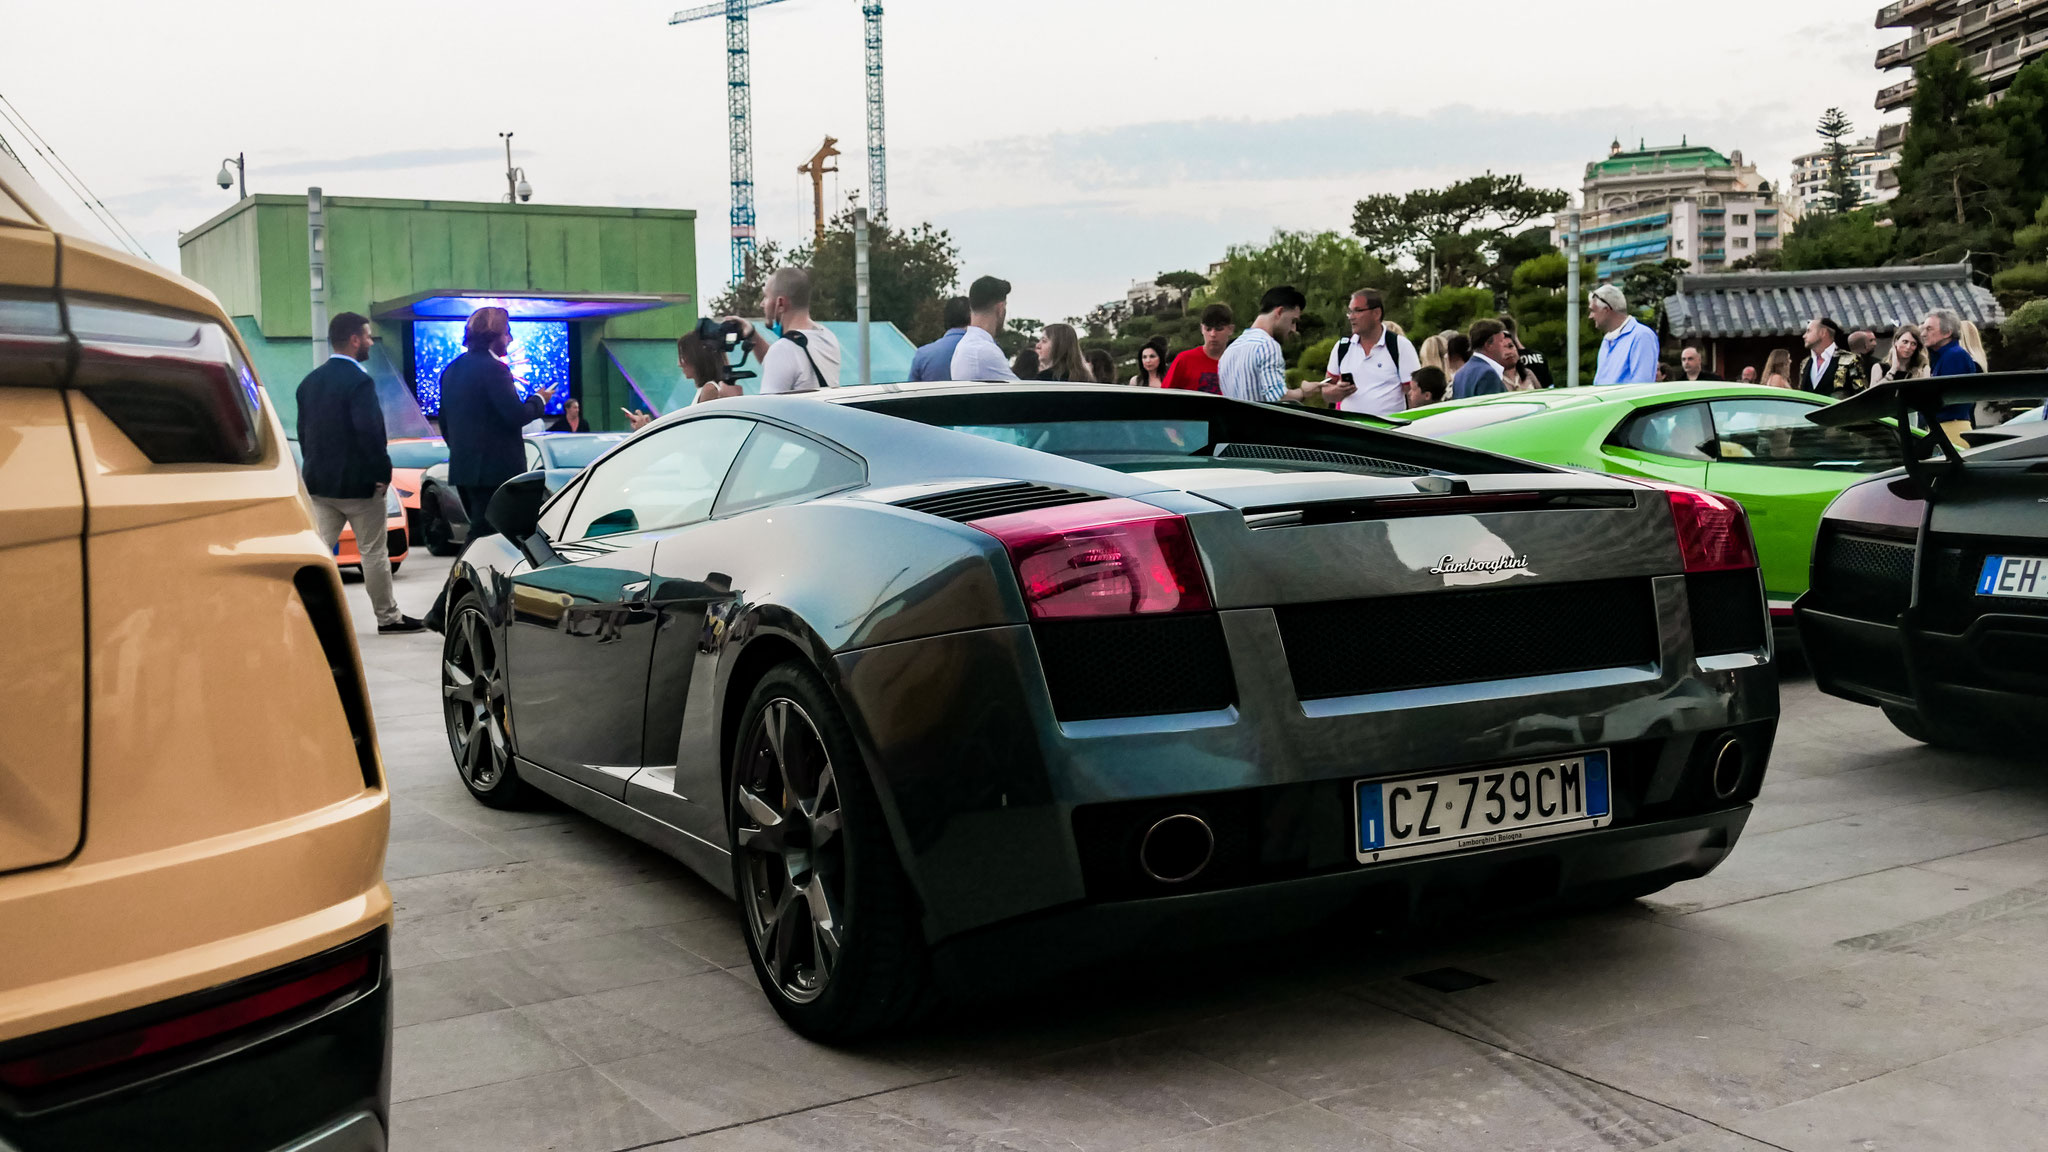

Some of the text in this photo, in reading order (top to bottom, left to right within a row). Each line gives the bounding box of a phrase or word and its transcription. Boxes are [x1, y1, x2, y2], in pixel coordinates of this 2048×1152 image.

[1429, 554, 1529, 575] Lamborghini
[1998, 559, 2042, 593] EH
[1458, 762, 1582, 829] 739CM
[1458, 832, 1522, 848] Lamborghini Bologna
